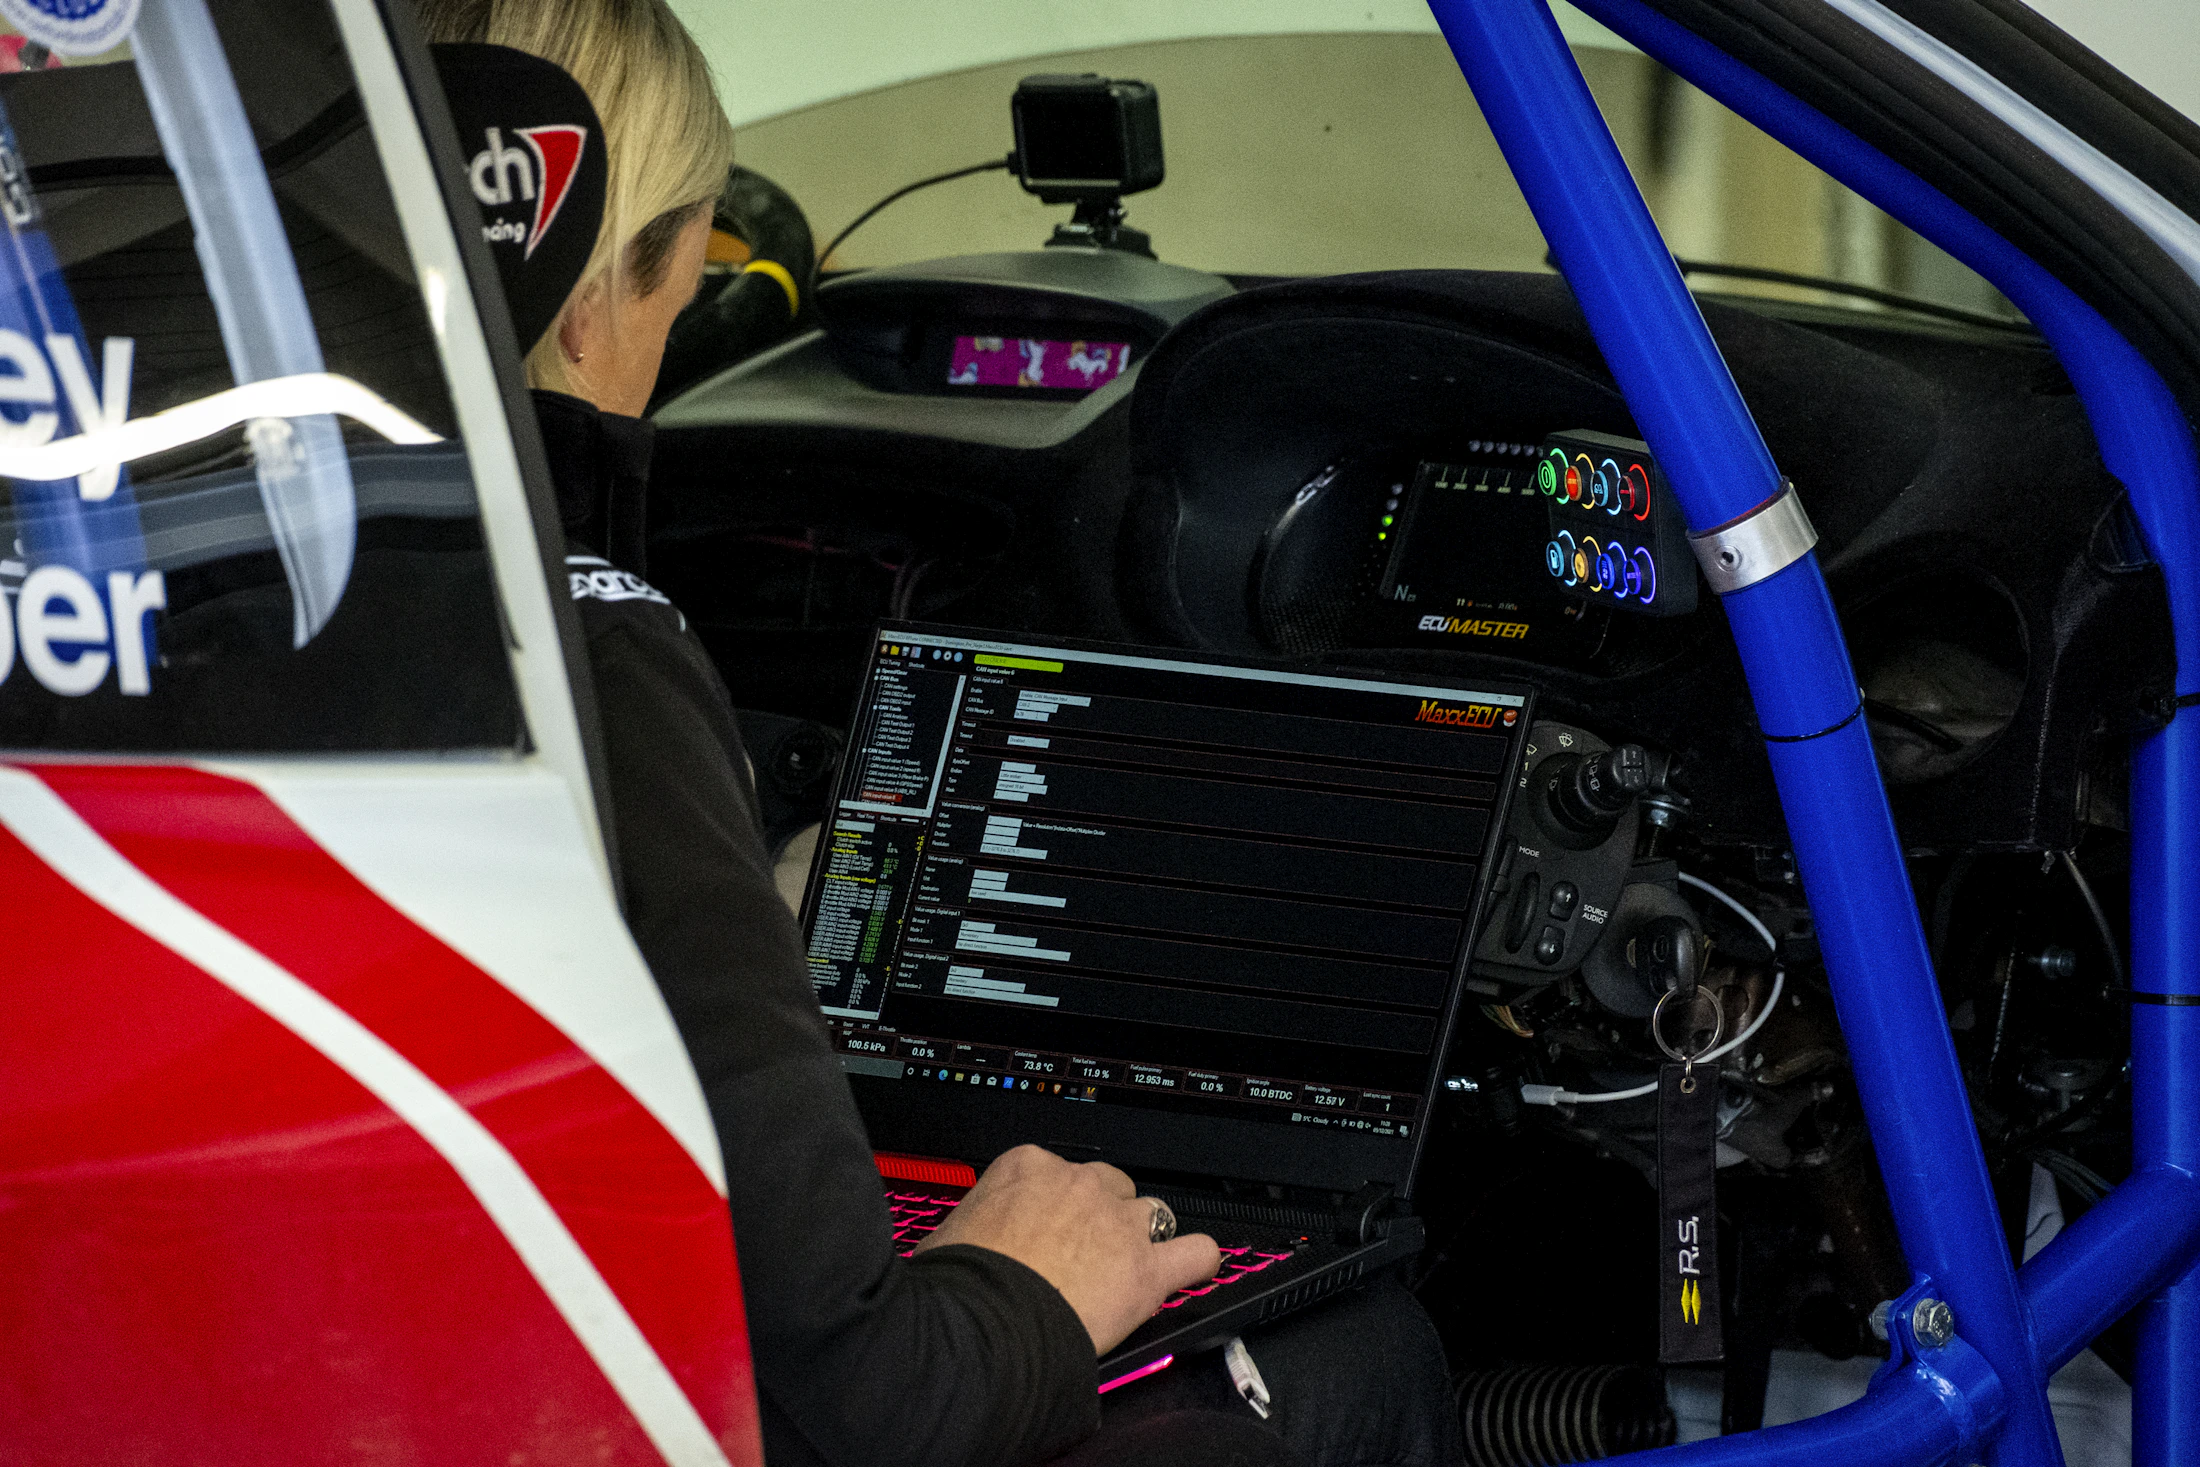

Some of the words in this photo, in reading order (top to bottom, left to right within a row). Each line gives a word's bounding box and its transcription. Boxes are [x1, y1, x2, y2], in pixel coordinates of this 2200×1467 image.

[462, 127, 536, 206] ch
[0, 329, 135, 501] ey
[0, 565, 167, 696] er
[1415, 700, 1502, 729] MaxxECU
[1519, 777, 1527, 788] 2
[1518, 846, 1540, 858] MODE
[1583, 904, 1609, 918] SOURCE
[1581, 912, 1604, 924] AUDIO
[869, 1042, 886, 1052] kPa
[911, 1047, 925, 1057] 0.0
[1023, 1060, 1041, 1070] 73.8
[1082, 1067, 1101, 1077] 11.9
[1134, 1073, 1162, 1085] 12.953
[1200, 1081, 1214, 1091] 0.0
[1249, 1086, 1267, 1097] 10.0
[1267, 1089, 1293, 1100] BTDC
